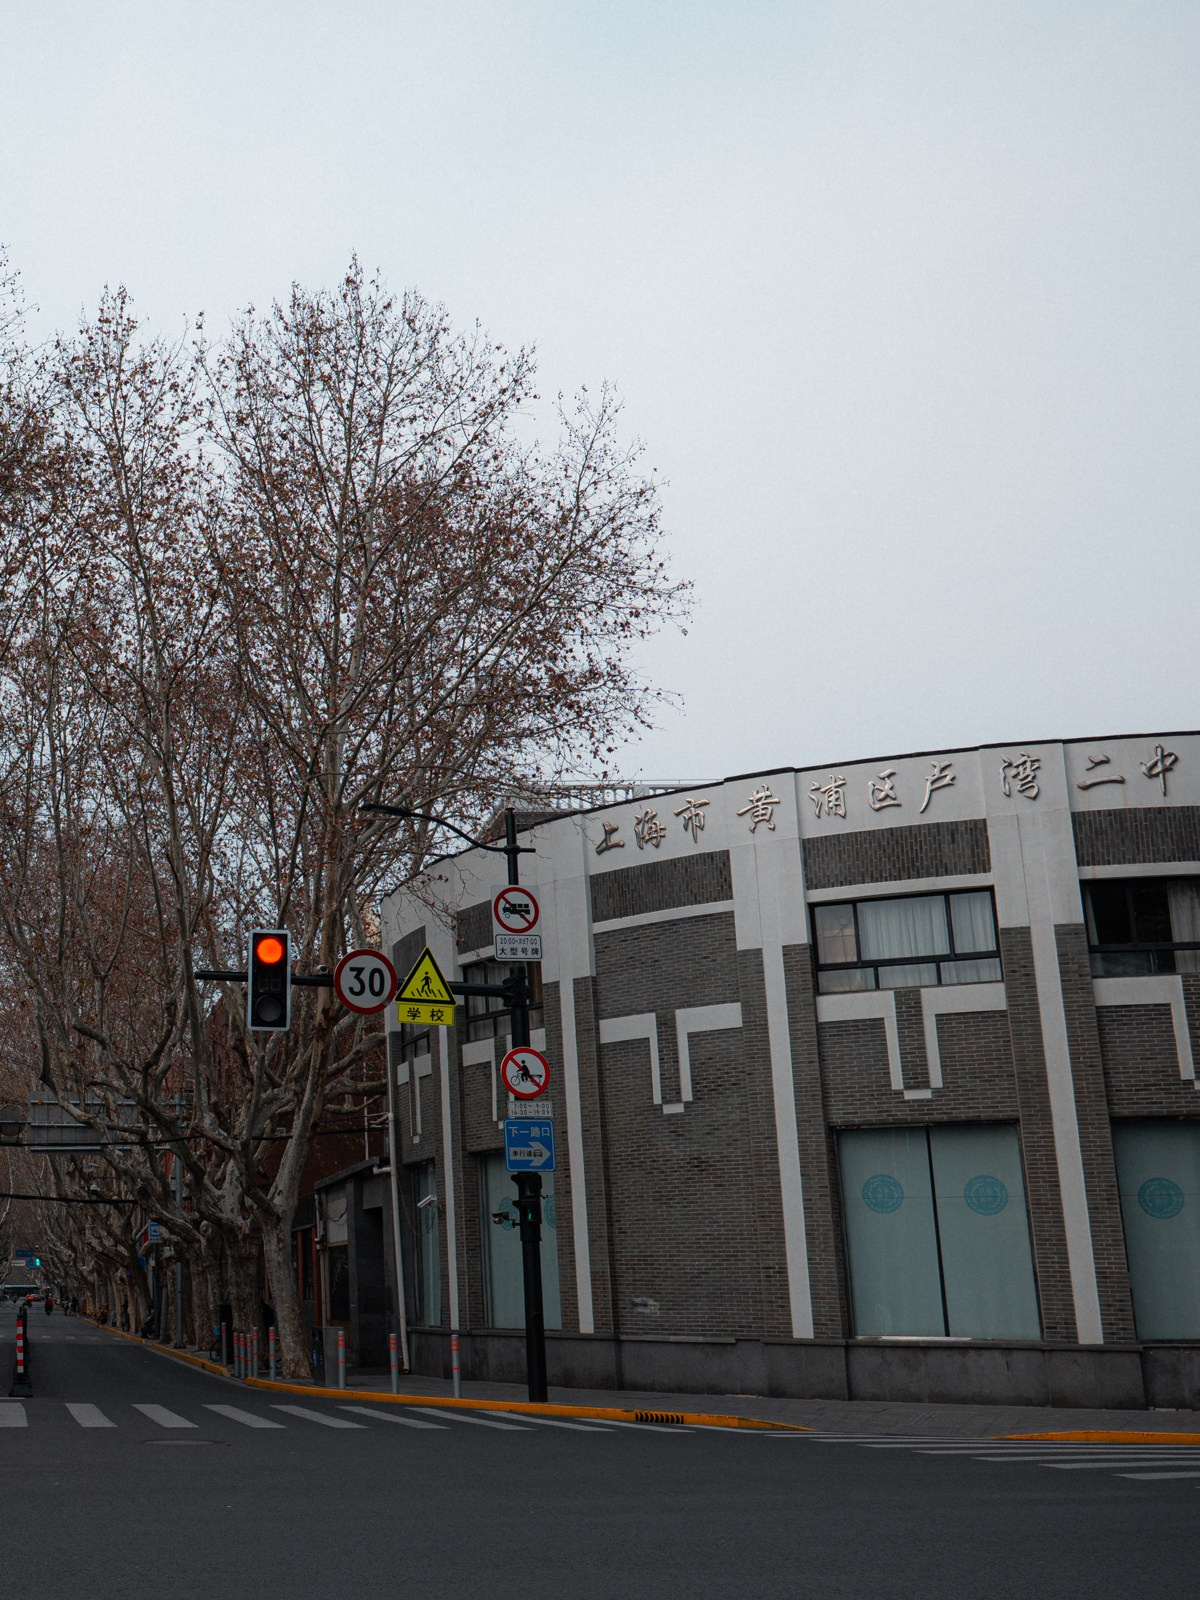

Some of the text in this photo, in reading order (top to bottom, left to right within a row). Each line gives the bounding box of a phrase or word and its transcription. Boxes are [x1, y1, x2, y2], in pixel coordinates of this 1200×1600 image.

[594, 743, 1180, 856] 上海市黄浦区卢湾二中
[499, 946, 539, 956] 大型号牌
[348, 966, 385, 997] 30
[406, 1007, 444, 1023] 学校
[508, 1126, 550, 1137] 下一路口
